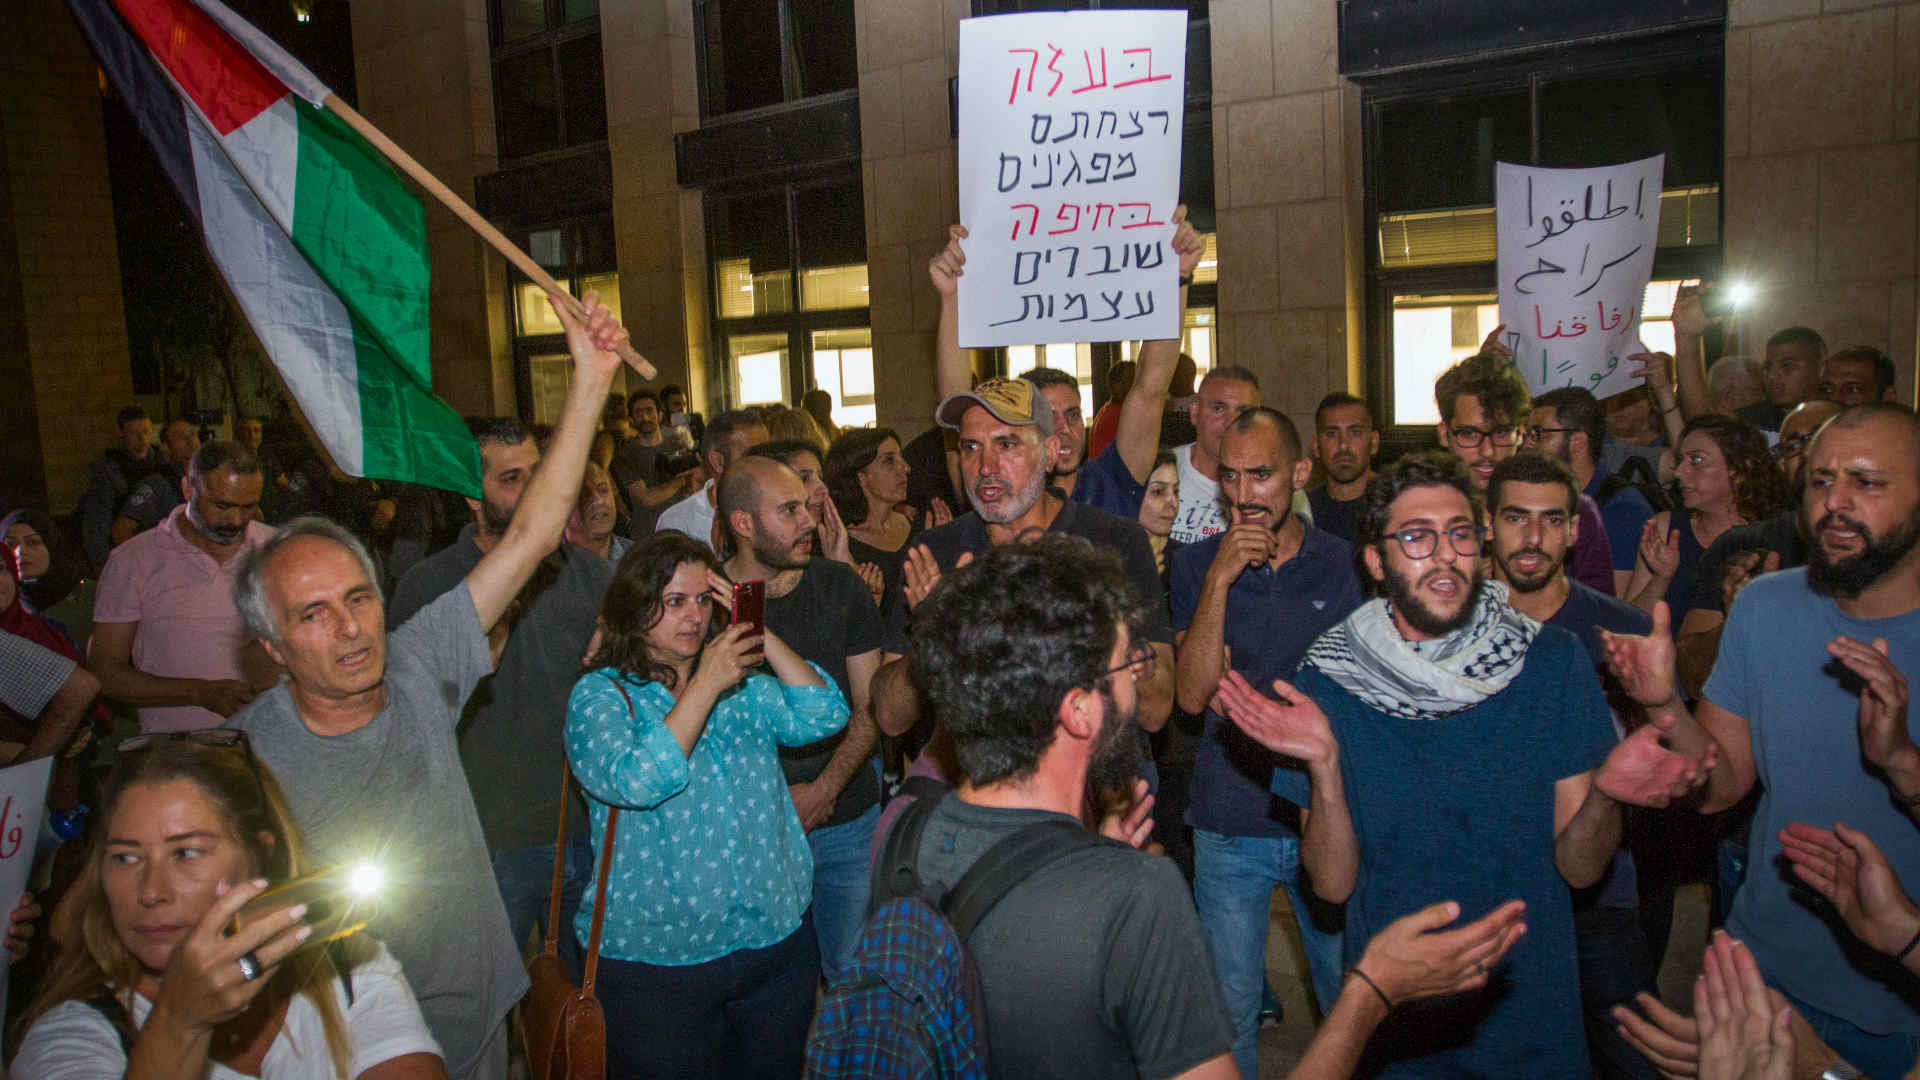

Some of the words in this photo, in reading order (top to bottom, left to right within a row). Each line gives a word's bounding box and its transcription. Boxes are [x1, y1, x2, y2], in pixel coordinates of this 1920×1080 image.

[1030, 110, 1169, 144] רצחתם
[997, 150, 1137, 193] מפגינים
[1010, 202, 1165, 241] בחיפה
[1013, 240, 1163, 286] שוברים
[988, 289, 1154, 328] עצמות
